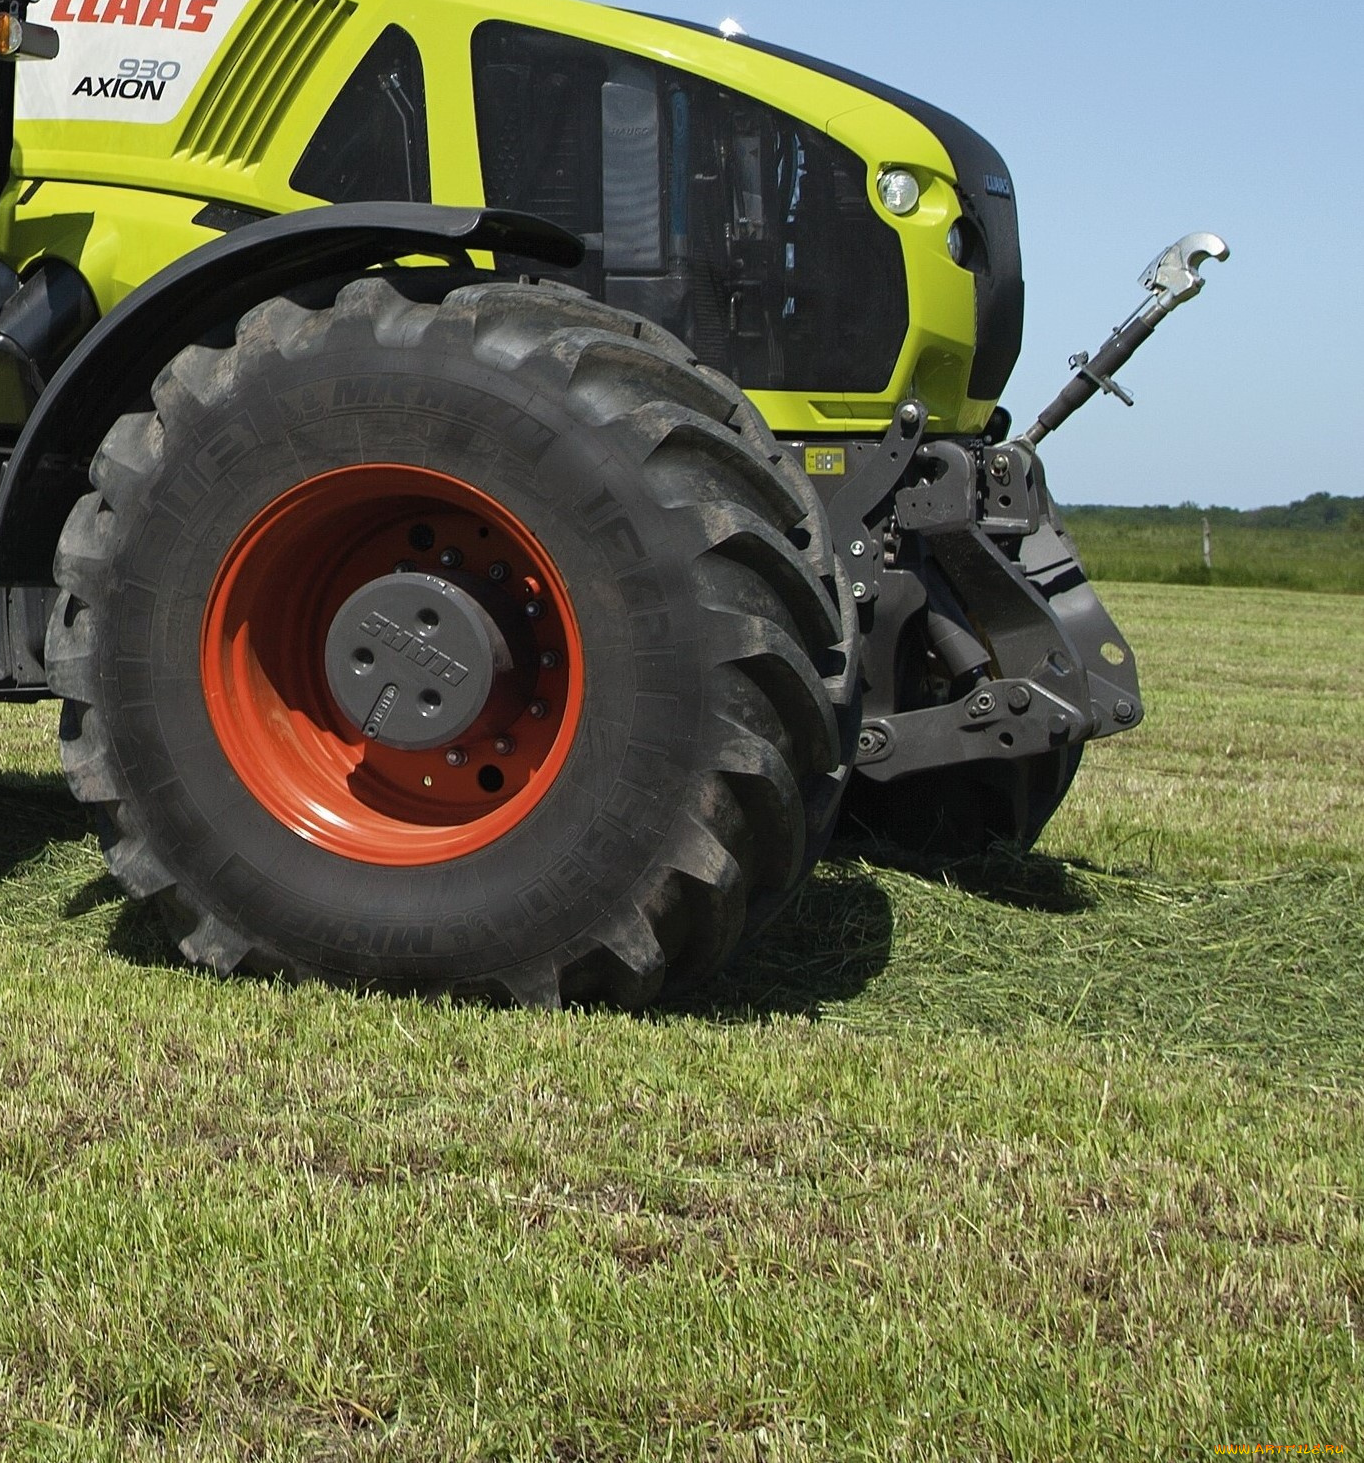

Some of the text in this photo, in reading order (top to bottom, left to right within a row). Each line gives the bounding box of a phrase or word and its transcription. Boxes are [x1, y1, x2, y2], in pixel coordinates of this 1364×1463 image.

[116, 58, 182, 81] 930
[73, 76, 167, 101] AXION
[359, 610, 470, 687] CLAAS
